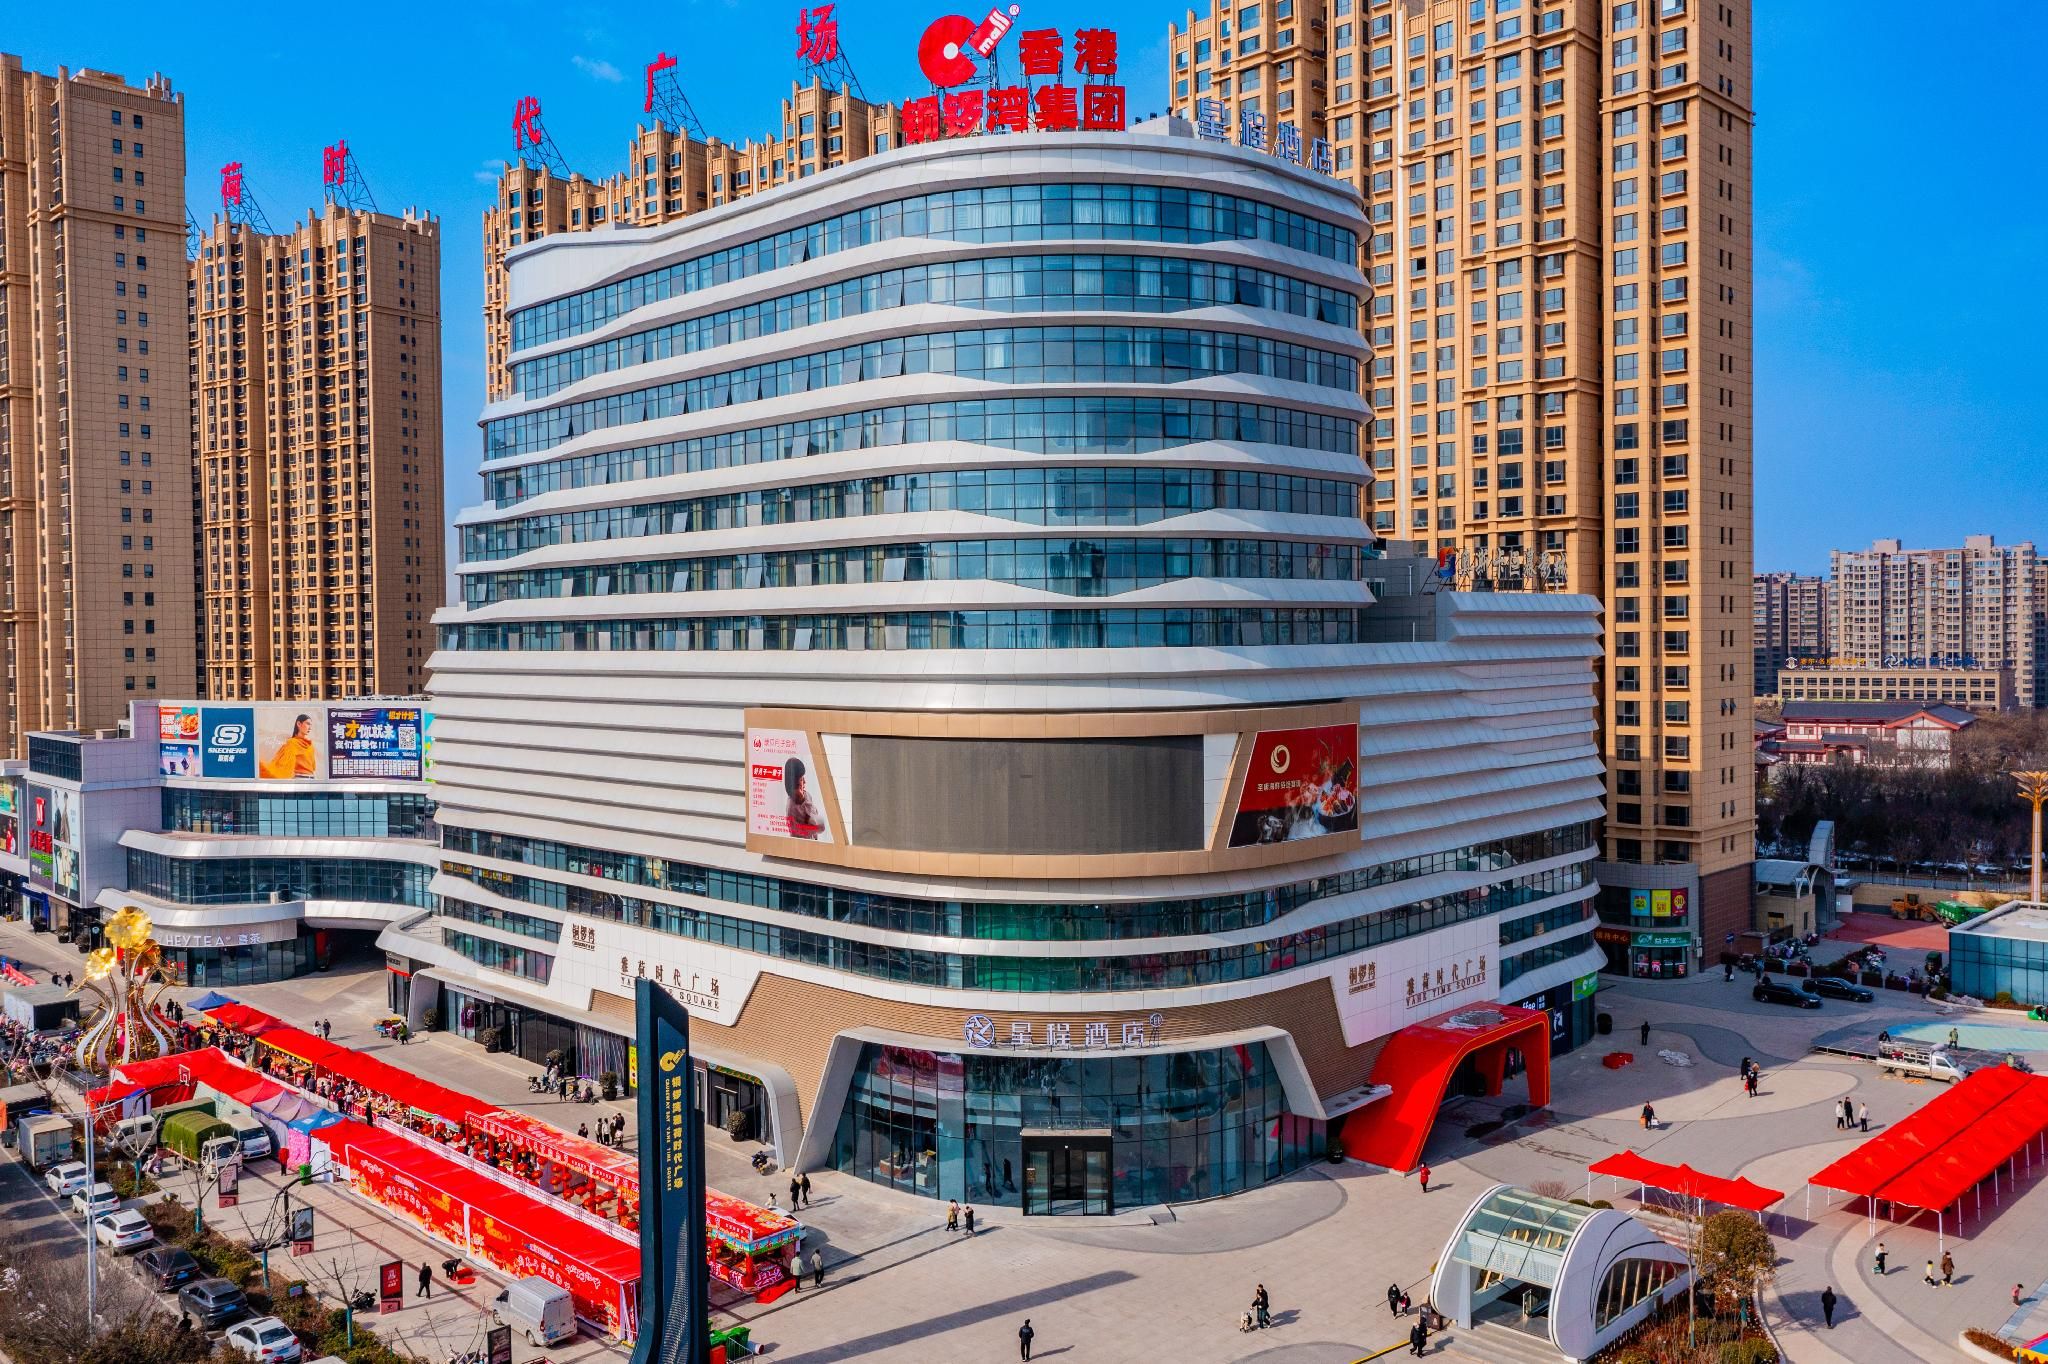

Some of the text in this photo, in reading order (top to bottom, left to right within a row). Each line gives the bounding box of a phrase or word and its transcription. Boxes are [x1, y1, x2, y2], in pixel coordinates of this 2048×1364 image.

[979, 9, 1010, 54] mall
[1019, 28, 1118, 76] 香港
[221, 4, 837, 206] 荷 时 代 广 场
[902, 83, 1126, 144] 铜锣湾集团
[1199, 98, 1333, 175] 星程酒店
[332, 720, 395, 739] 有才你就来
[166, 932, 261, 947] HEYTEA 喜茶
[572, 923, 595, 944] 铜锣湾
[1349, 961, 1376, 985] 铜锣湾
[1406, 955, 1486, 996] 雅荷时代广场
[680, 991, 720, 1009] SQUARE
[1011, 1021, 1143, 1048] 星程酒店
